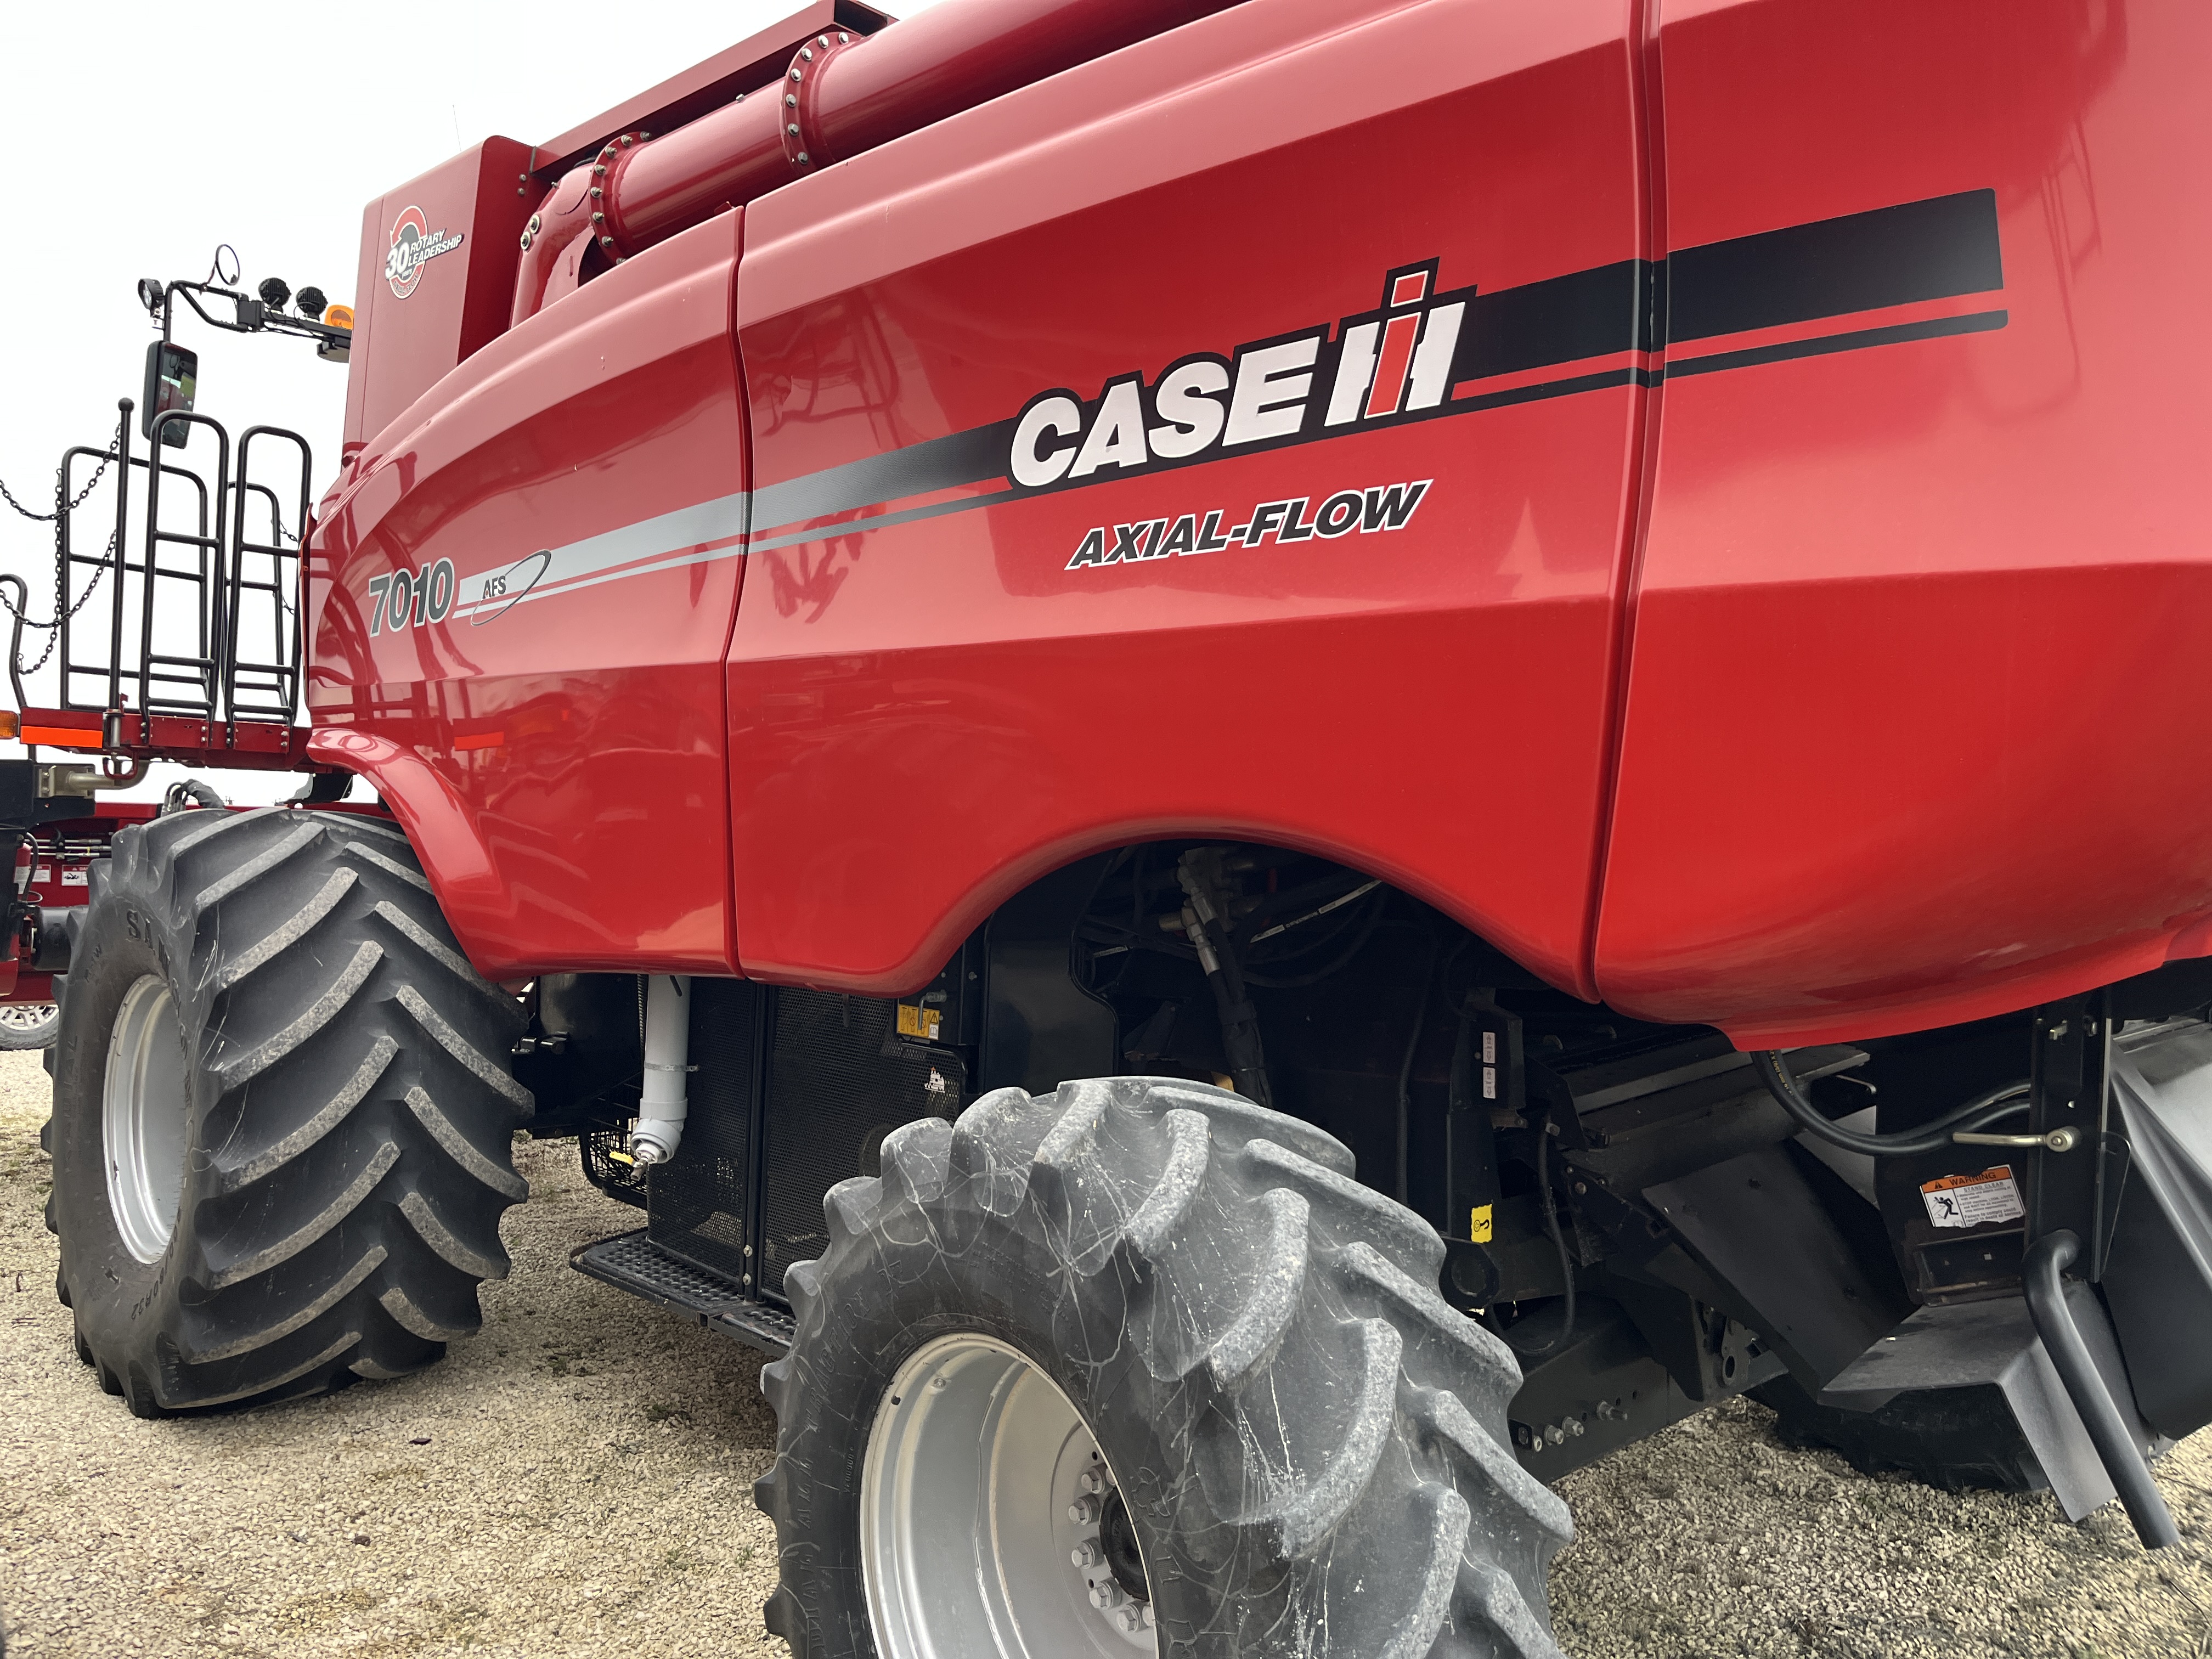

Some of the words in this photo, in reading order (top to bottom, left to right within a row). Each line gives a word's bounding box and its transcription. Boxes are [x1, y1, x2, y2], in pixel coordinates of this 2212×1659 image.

[408, 234, 462, 267] LEADERSHIP
[410, 228, 446, 254] ROTARY
[385, 242, 410, 280] 30
[1010, 336, 1320, 487] CASE
[1064, 479, 1433, 570] AXIAL-FLOW
[369, 557, 455, 638] 7010
[482, 575, 506, 599] AFS
[1949, 1172, 1996, 1186] WARNING
